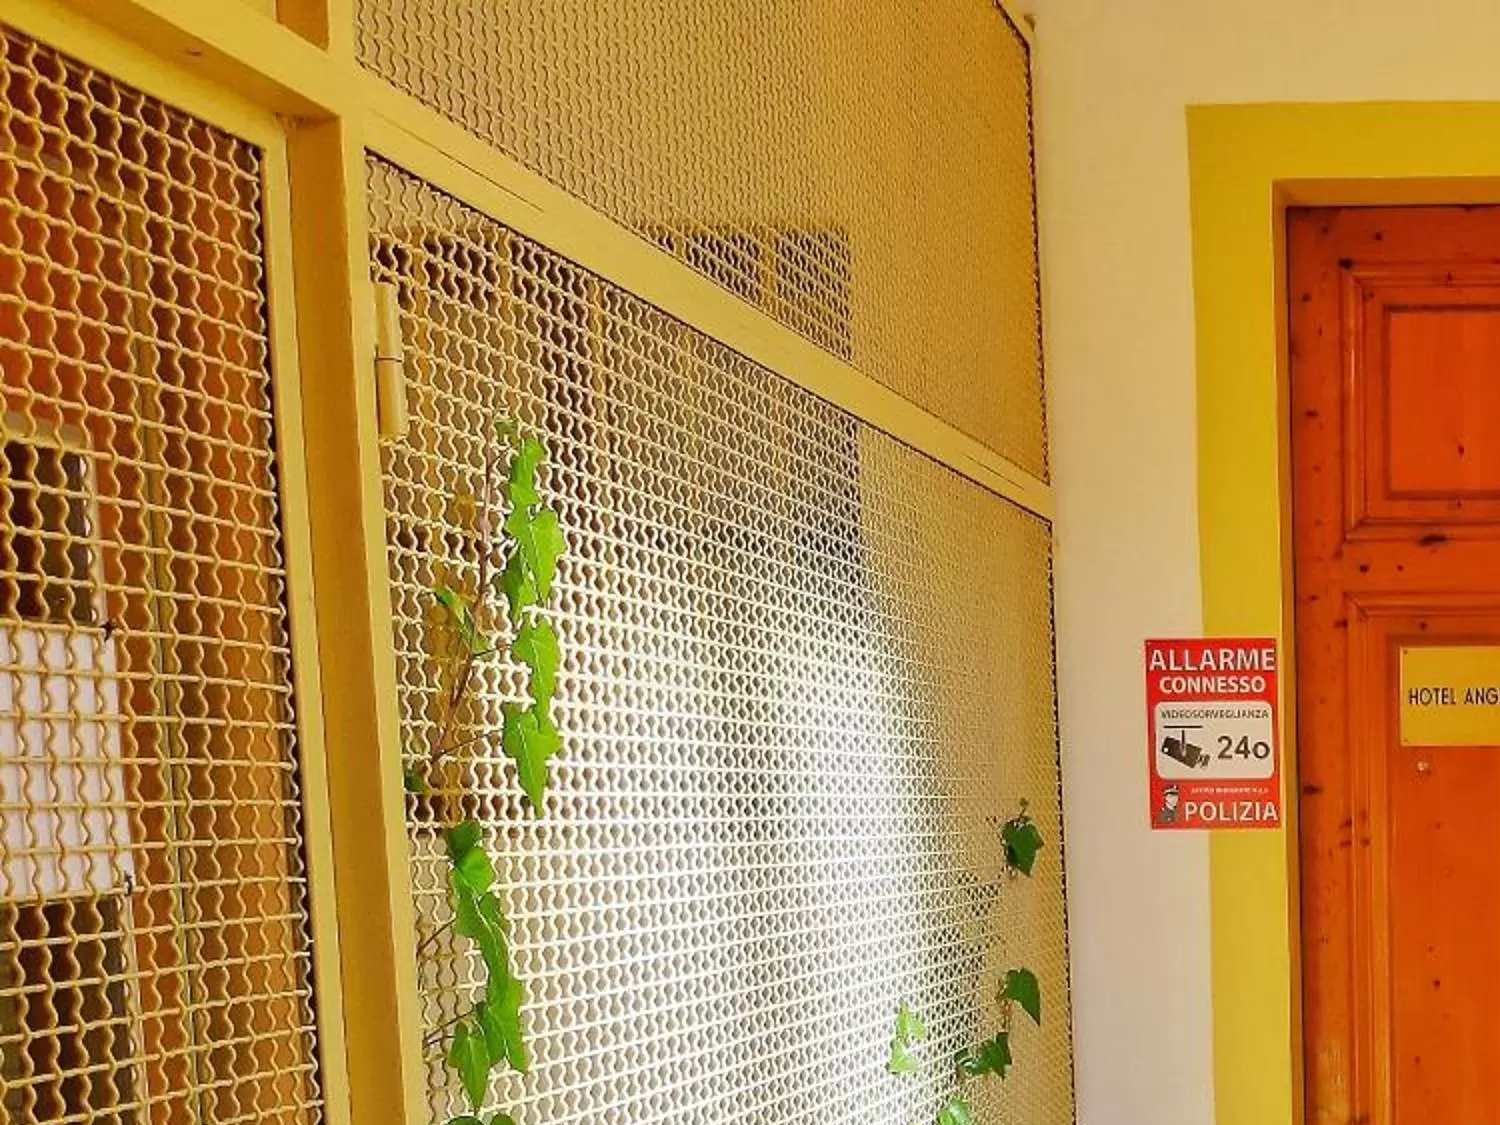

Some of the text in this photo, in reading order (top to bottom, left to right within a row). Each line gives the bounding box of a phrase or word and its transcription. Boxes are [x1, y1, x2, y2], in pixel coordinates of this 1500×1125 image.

[1150, 648, 1275, 671] ALLARME
[1159, 675, 1266, 693] CONNESSO
[1408, 687, 1456, 705] HOTEL
[1161, 708, 1269, 719] VIDEOSORVEGLIANZA
[1184, 801, 1279, 821] POLIZIA
